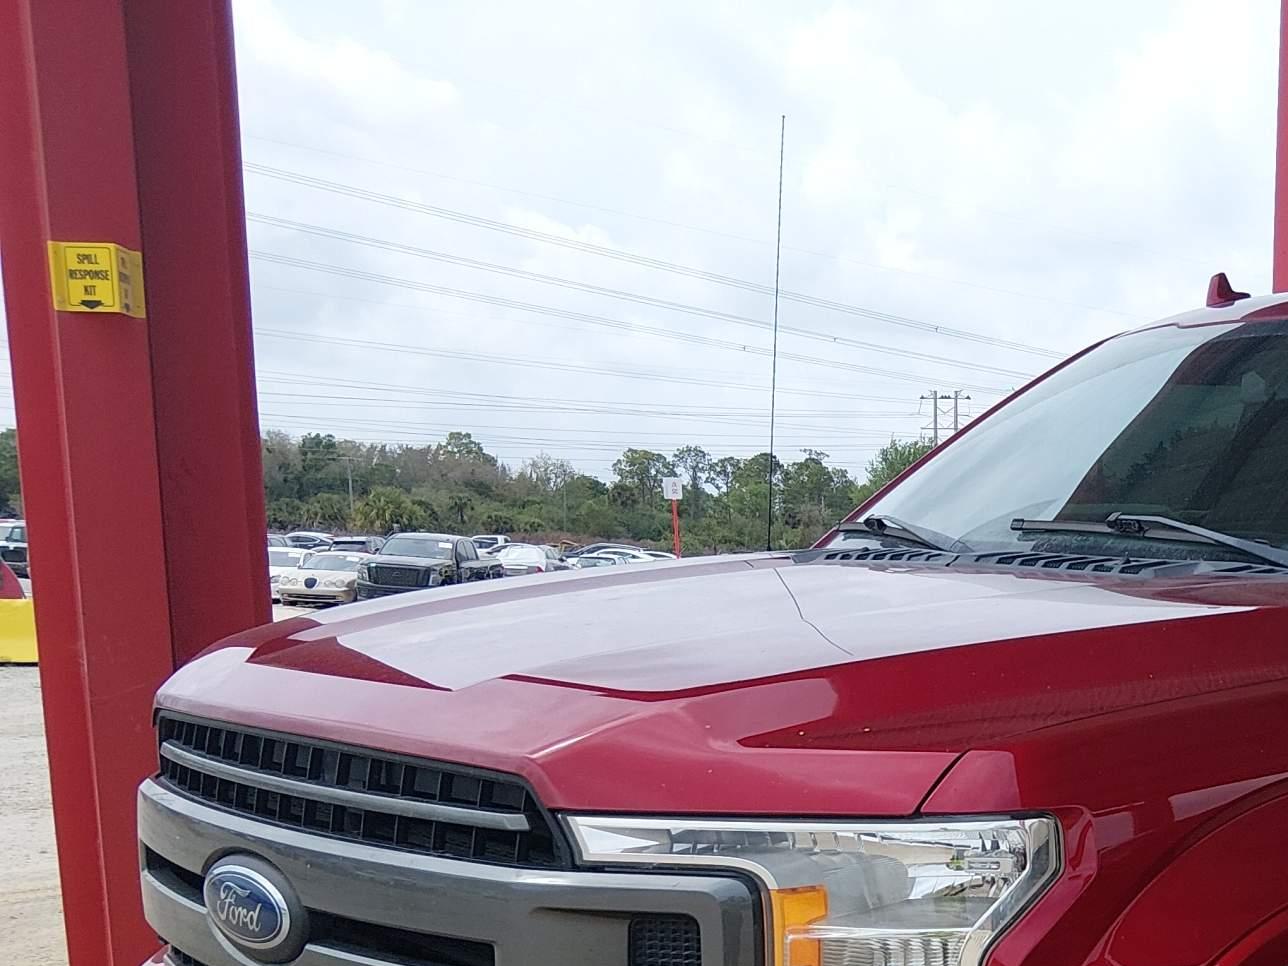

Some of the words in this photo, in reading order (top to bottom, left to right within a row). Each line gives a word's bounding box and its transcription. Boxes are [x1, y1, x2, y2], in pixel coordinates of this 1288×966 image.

[76, 253, 100, 265] SPILL
[68, 269, 110, 281] RESPONSE
[83, 285, 97, 296] KIT
[216, 881, 263, 932] Ford
